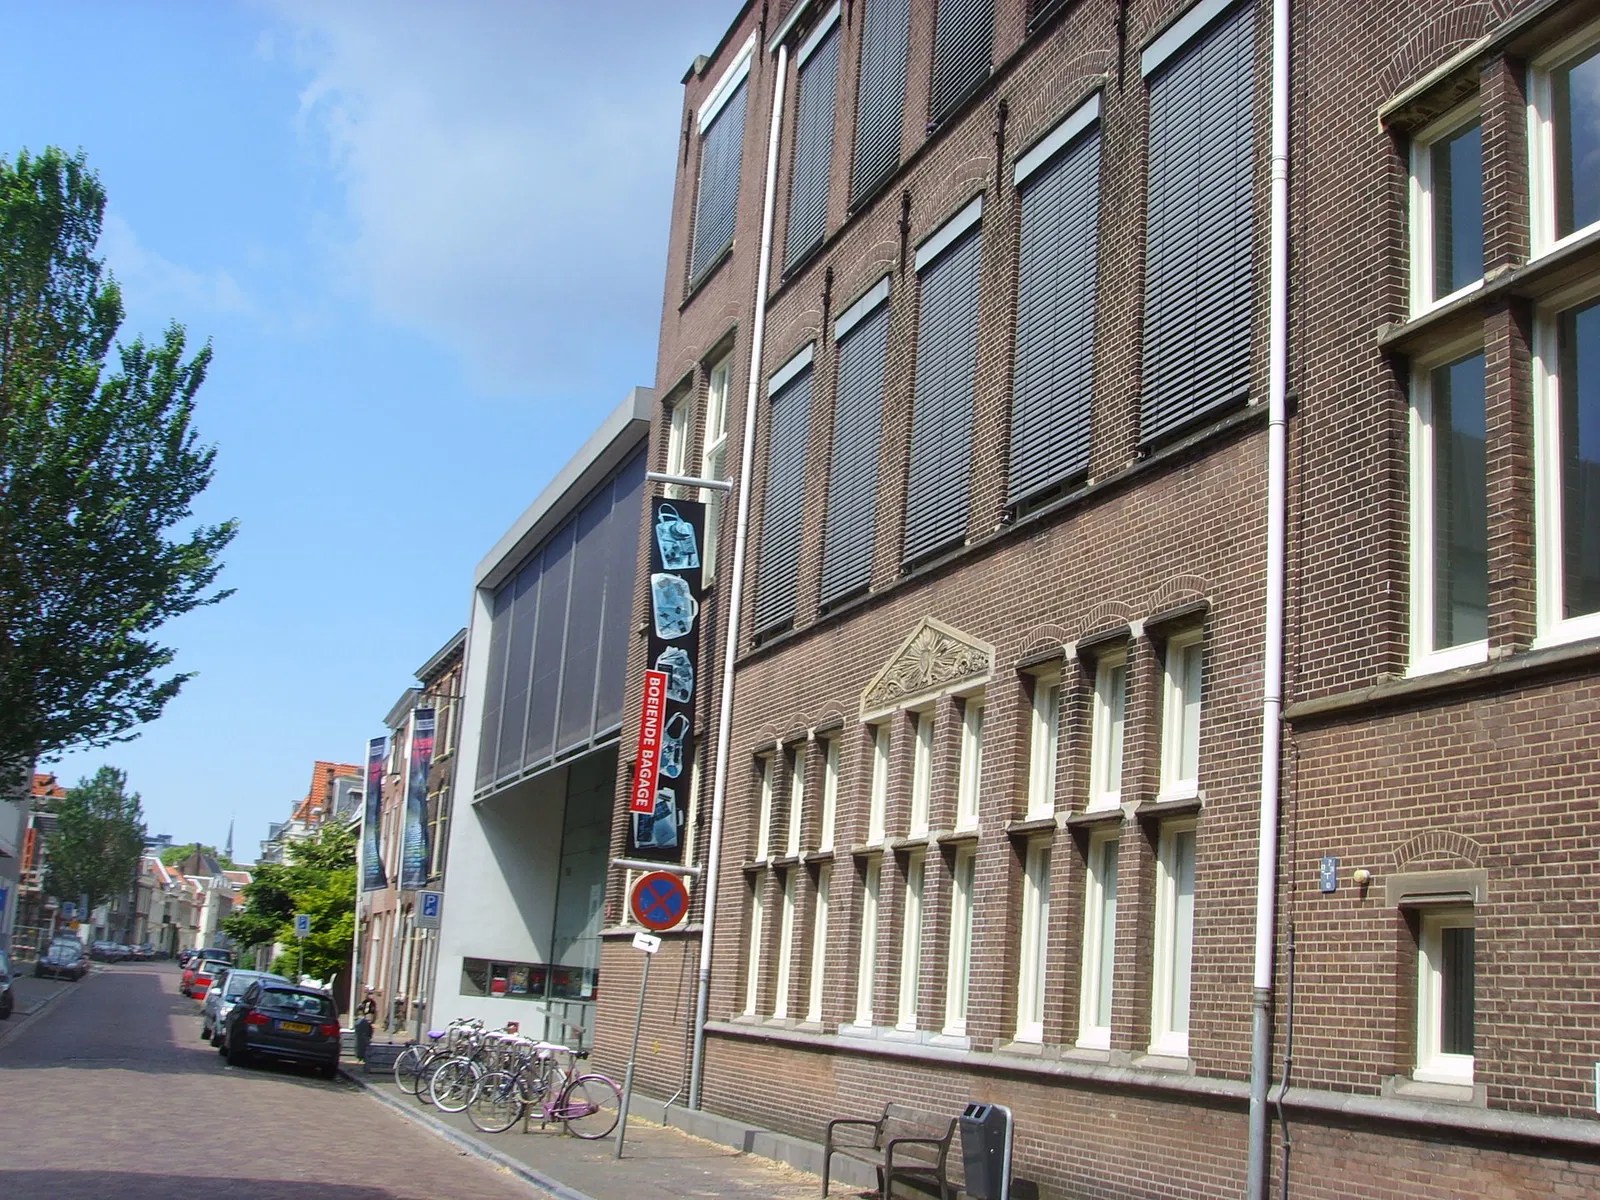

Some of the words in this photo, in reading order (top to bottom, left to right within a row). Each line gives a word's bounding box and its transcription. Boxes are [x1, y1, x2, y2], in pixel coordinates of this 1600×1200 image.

[643, 677, 661, 746] BOEIENDE
[635, 750, 654, 807] BAGAGE
[425, 895, 436, 907] P
